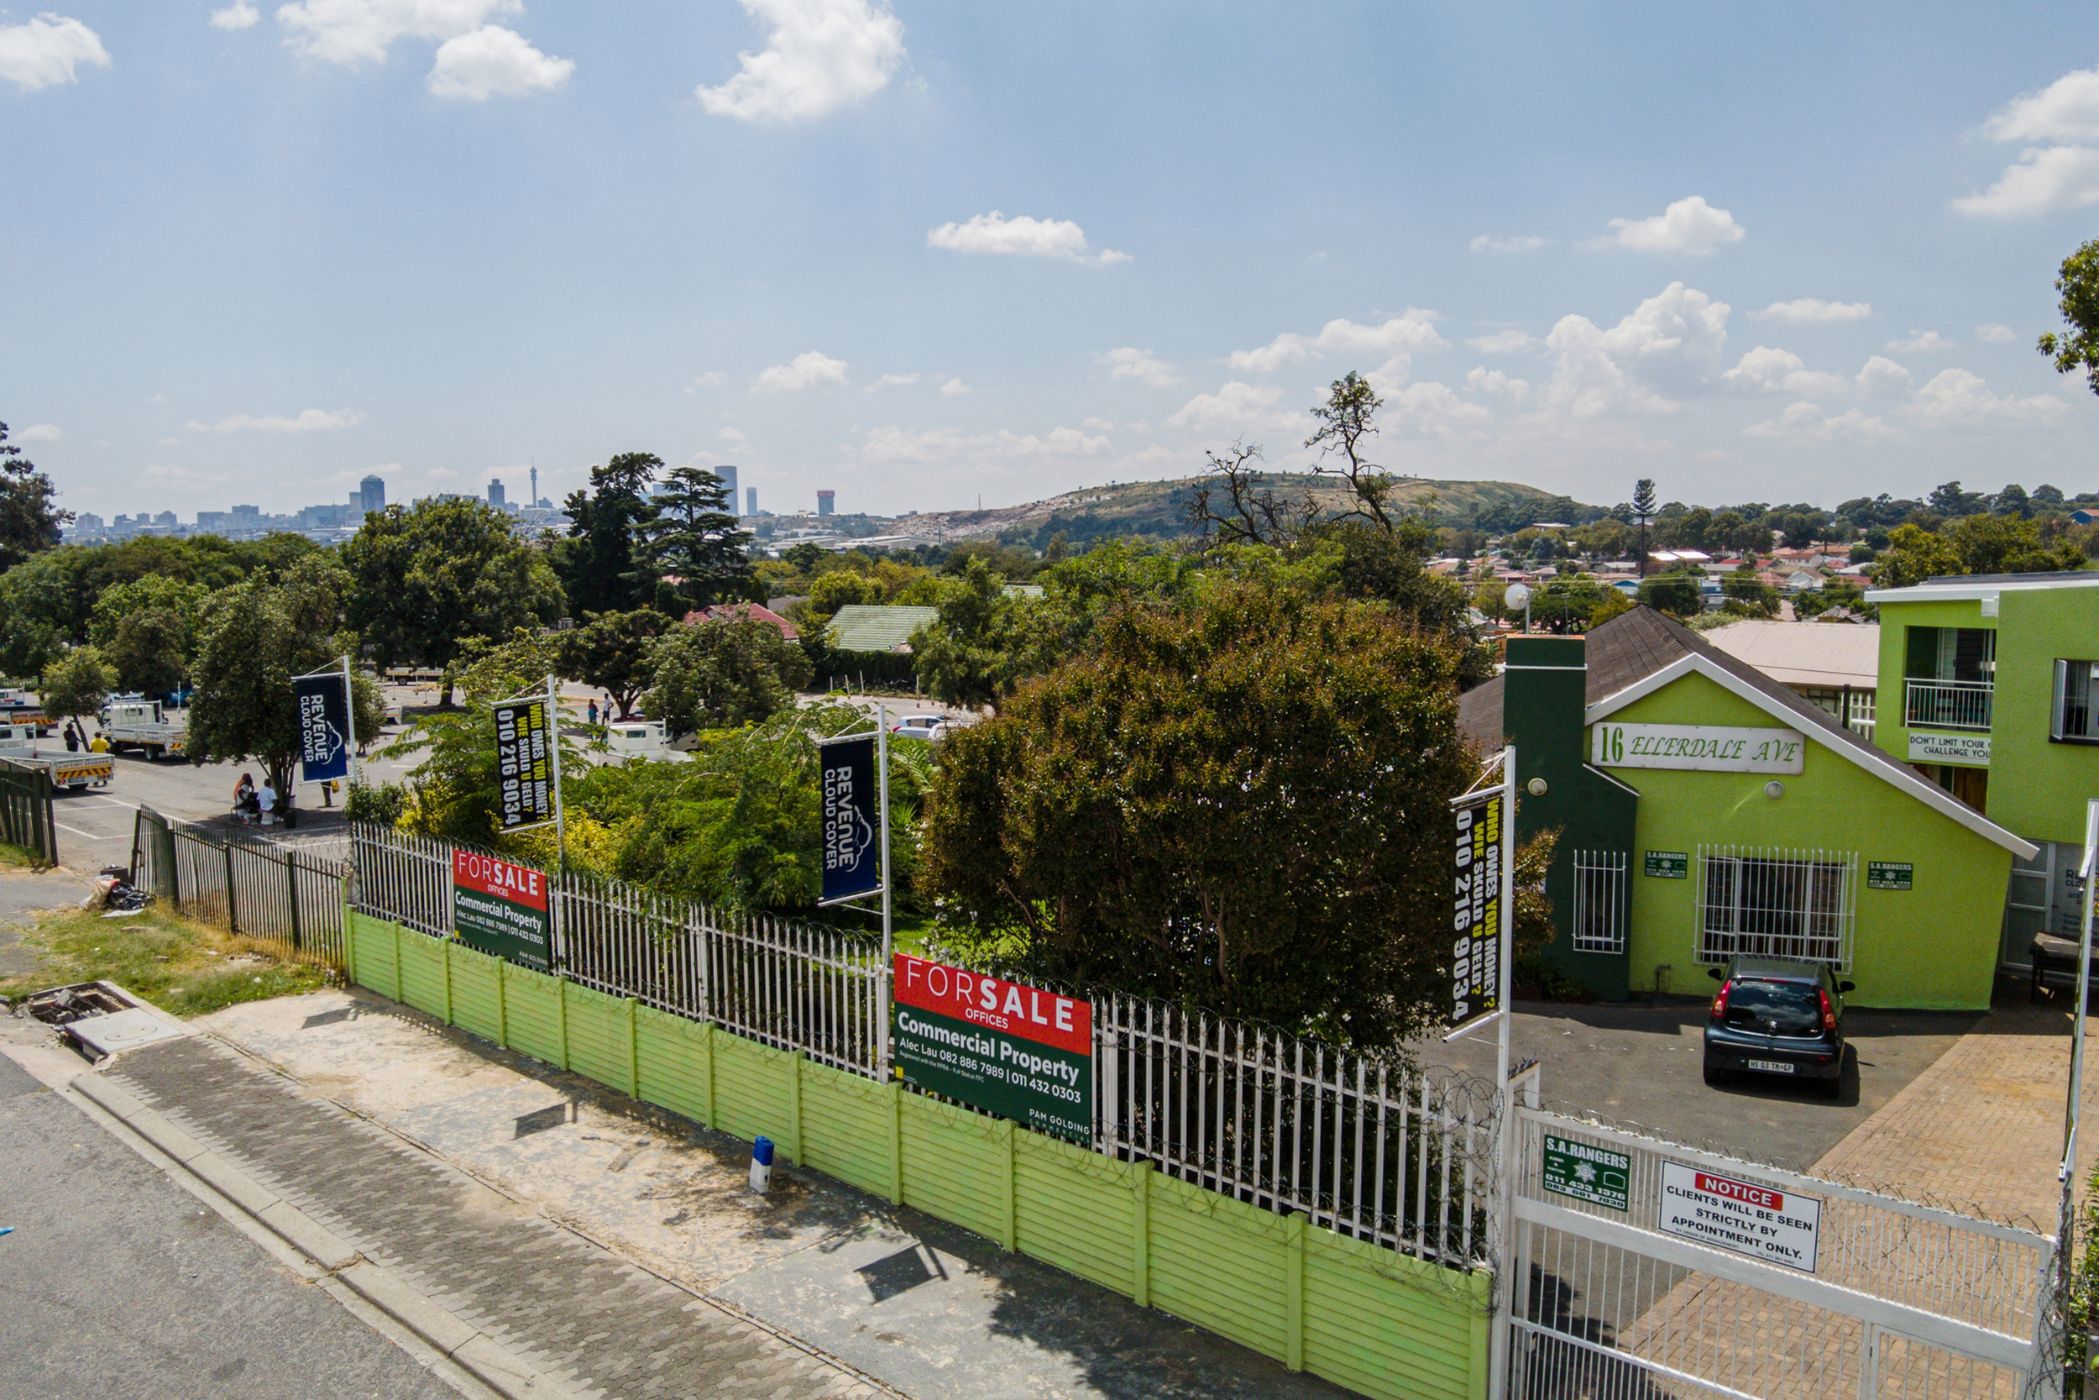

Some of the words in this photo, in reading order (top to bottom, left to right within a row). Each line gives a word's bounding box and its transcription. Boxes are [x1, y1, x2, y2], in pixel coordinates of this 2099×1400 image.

[300, 696, 311, 728] CLOUD
[310, 694, 328, 761] REVENUE
[497, 709, 516, 741] 010
[517, 716, 529, 737] WIE
[529, 704, 543, 729] WHO
[303, 730, 314, 762] COVER
[519, 738, 531, 771] SKULD
[531, 730, 545, 759] OWES
[1601, 726, 1624, 763] 16
[1630, 736, 1747, 760] ELLERDALE
[1752, 739, 1800, 762] AVE
[1910, 736, 1935, 745] DON'T
[1938, 738, 1957, 747] LIMIT
[1962, 739, 1985, 748] YOUR
[1924, 745, 1969, 757] CHALLENGE
[500, 744, 518, 776] 216
[520, 772, 531, 780] U
[533, 760, 546, 780] YOU
[502, 779, 521, 825] 9034
[522, 782, 533, 813] GELD?
[534, 781, 549, 820] MONEY?
[825, 769, 837, 817] CLOUD
[836, 766, 854, 868] REVENUE
[1486, 798, 1500, 843] WHO
[825, 821, 837, 870] COVER
[1455, 809, 1472, 868] 010
[1473, 821, 1485, 860] WIE
[1485, 845, 1498, 899] OWES
[487, 884, 509, 897] OFFICES
[1454, 873, 1471, 931] 216
[1472, 860, 1483, 922] SKULD
[455, 891, 503, 918] Commercial
[504, 905, 542, 933] Property
[1484, 899, 1497, 937] YOU
[1471, 924, 1483, 938] U
[1452, 936, 1470, 1021] 9034
[1471, 940, 1483, 996] GELD?
[1483, 937, 1497, 1009] MONEY?
[965, 1007, 1009, 1029] OFFICES
[898, 1011, 996, 1058] Commercial
[1000, 1040, 1080, 1086] Property
[899, 1037, 919, 1052] Alec
[921, 1043, 937, 1058] Lau
[939, 1051, 958, 1065] 082
[959, 1056, 978, 1071] 886
[979, 1062, 1004, 1079] 7989
[1011, 1071, 1027, 1087] 011
[1029, 1079, 1050, 1094] 432
[1051, 1085, 1082, 1104] 0303
[1029, 1108, 1047, 1122] PAM
[1049, 1115, 1090, 1135] GOLDING
[1546, 1137, 1628, 1170] S.A.RANGERS
[1545, 1173, 1565, 1184] 011
[1568, 1180, 1593, 1192] 433
[1705, 1177, 1773, 1206] NOTICE
[1666, 1185, 1718, 1206] CLIENTS
[1722, 1199, 1752, 1216] WILL
[1756, 1209, 1773, 1222] BE
[1777, 1215, 1813, 1232] SEEN
[1696, 1207, 1756, 1232] STRICTLY
[1760, 1225, 1778, 1237] BY
[1671, 1215, 1762, 1248] APPOINTMENT
[1765, 1242, 1803, 1260] ONLY.
